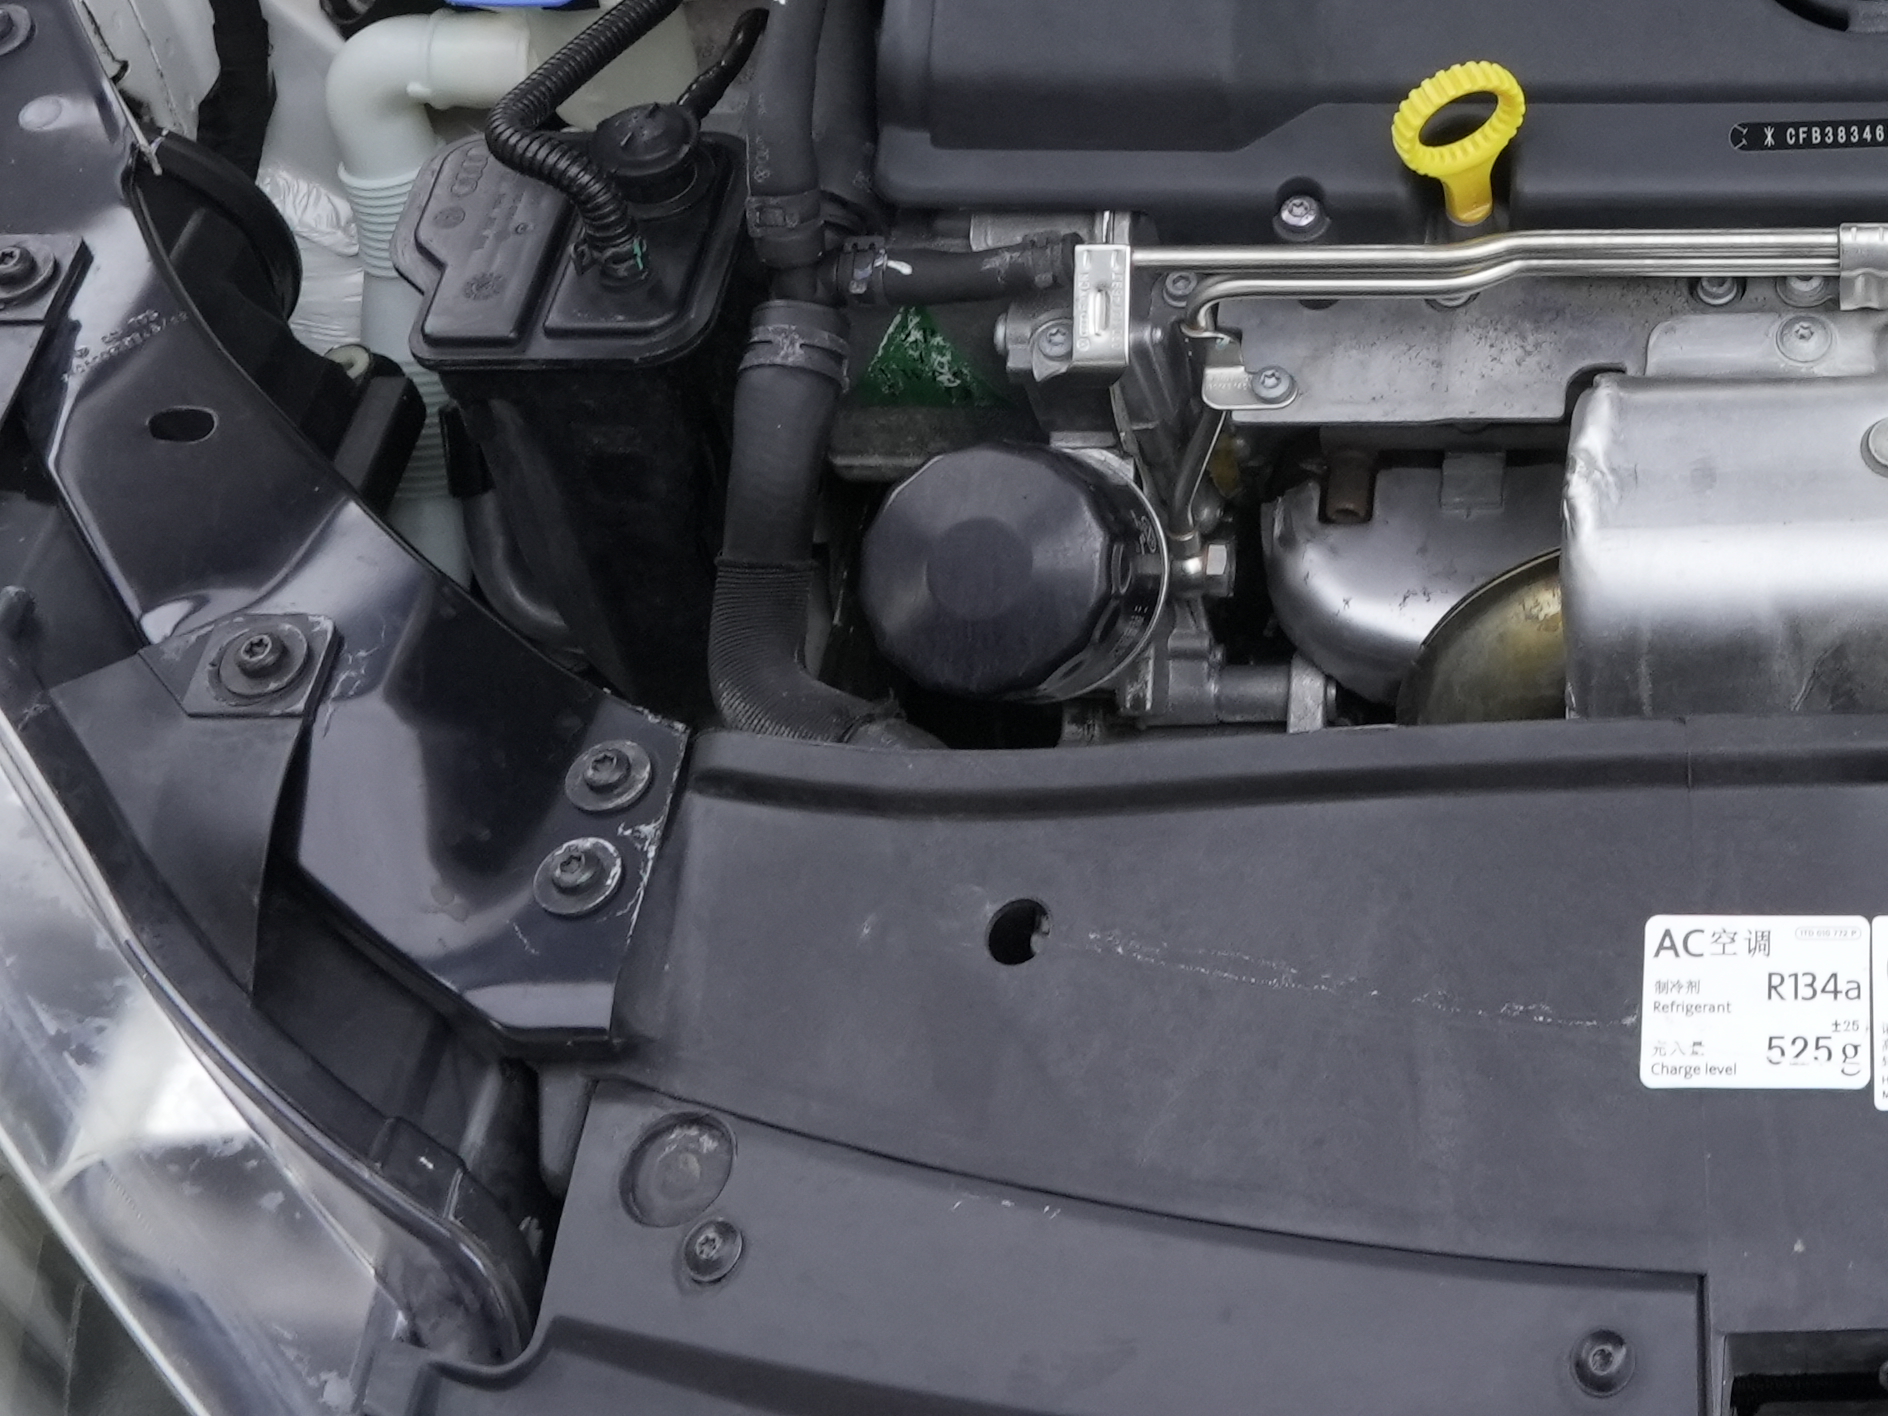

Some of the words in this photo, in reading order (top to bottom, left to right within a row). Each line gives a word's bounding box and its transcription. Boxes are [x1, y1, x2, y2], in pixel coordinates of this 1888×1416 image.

[1654, 979, 1701, 995] 制冷剂
[1767, 972, 1861, 1001] R134a
[1653, 1001, 1732, 1016] Refrigerant
[1650, 1062, 1701, 1079] Charge
[1705, 1062, 1737, 1075] level
